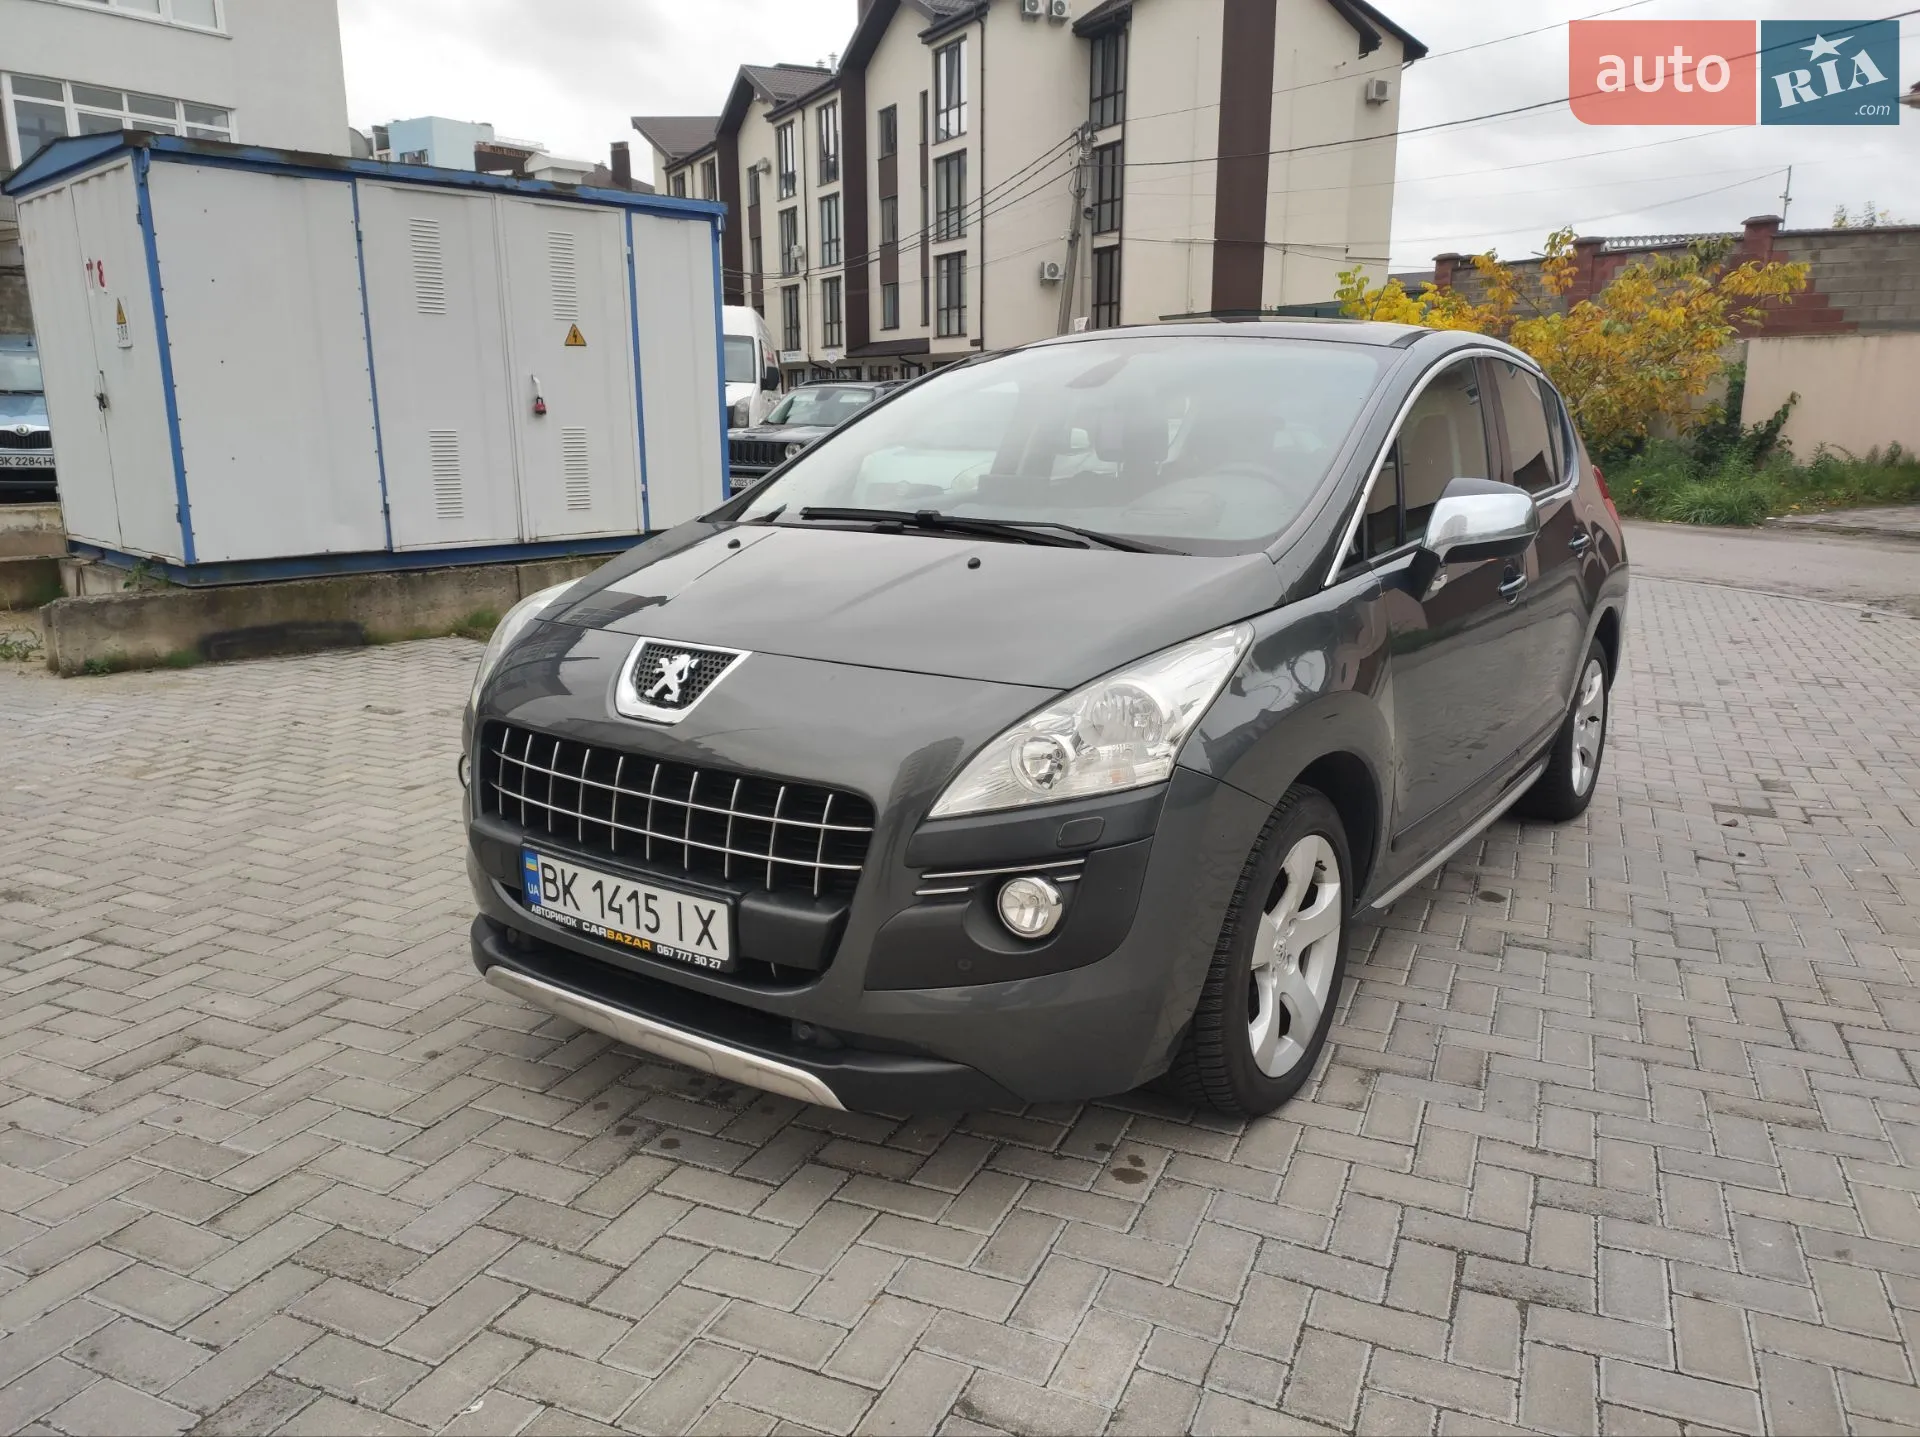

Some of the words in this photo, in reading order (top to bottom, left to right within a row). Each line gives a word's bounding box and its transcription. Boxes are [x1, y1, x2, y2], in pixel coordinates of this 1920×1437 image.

[15, 456, 42, 466] 2284
[527, 882, 539, 896] UA
[541, 862, 580, 911] BK
[592, 880, 660, 934] 1415
[677, 901, 718, 951] IX
[531, 904, 577, 928] АВТОРИНОК
[582, 922, 652, 951] CARBAZAR
[656, 944, 674, 957] 067
[676, 949, 692, 962] 777
[694, 954, 707, 967] 30
[709, 958, 722, 970] 27
